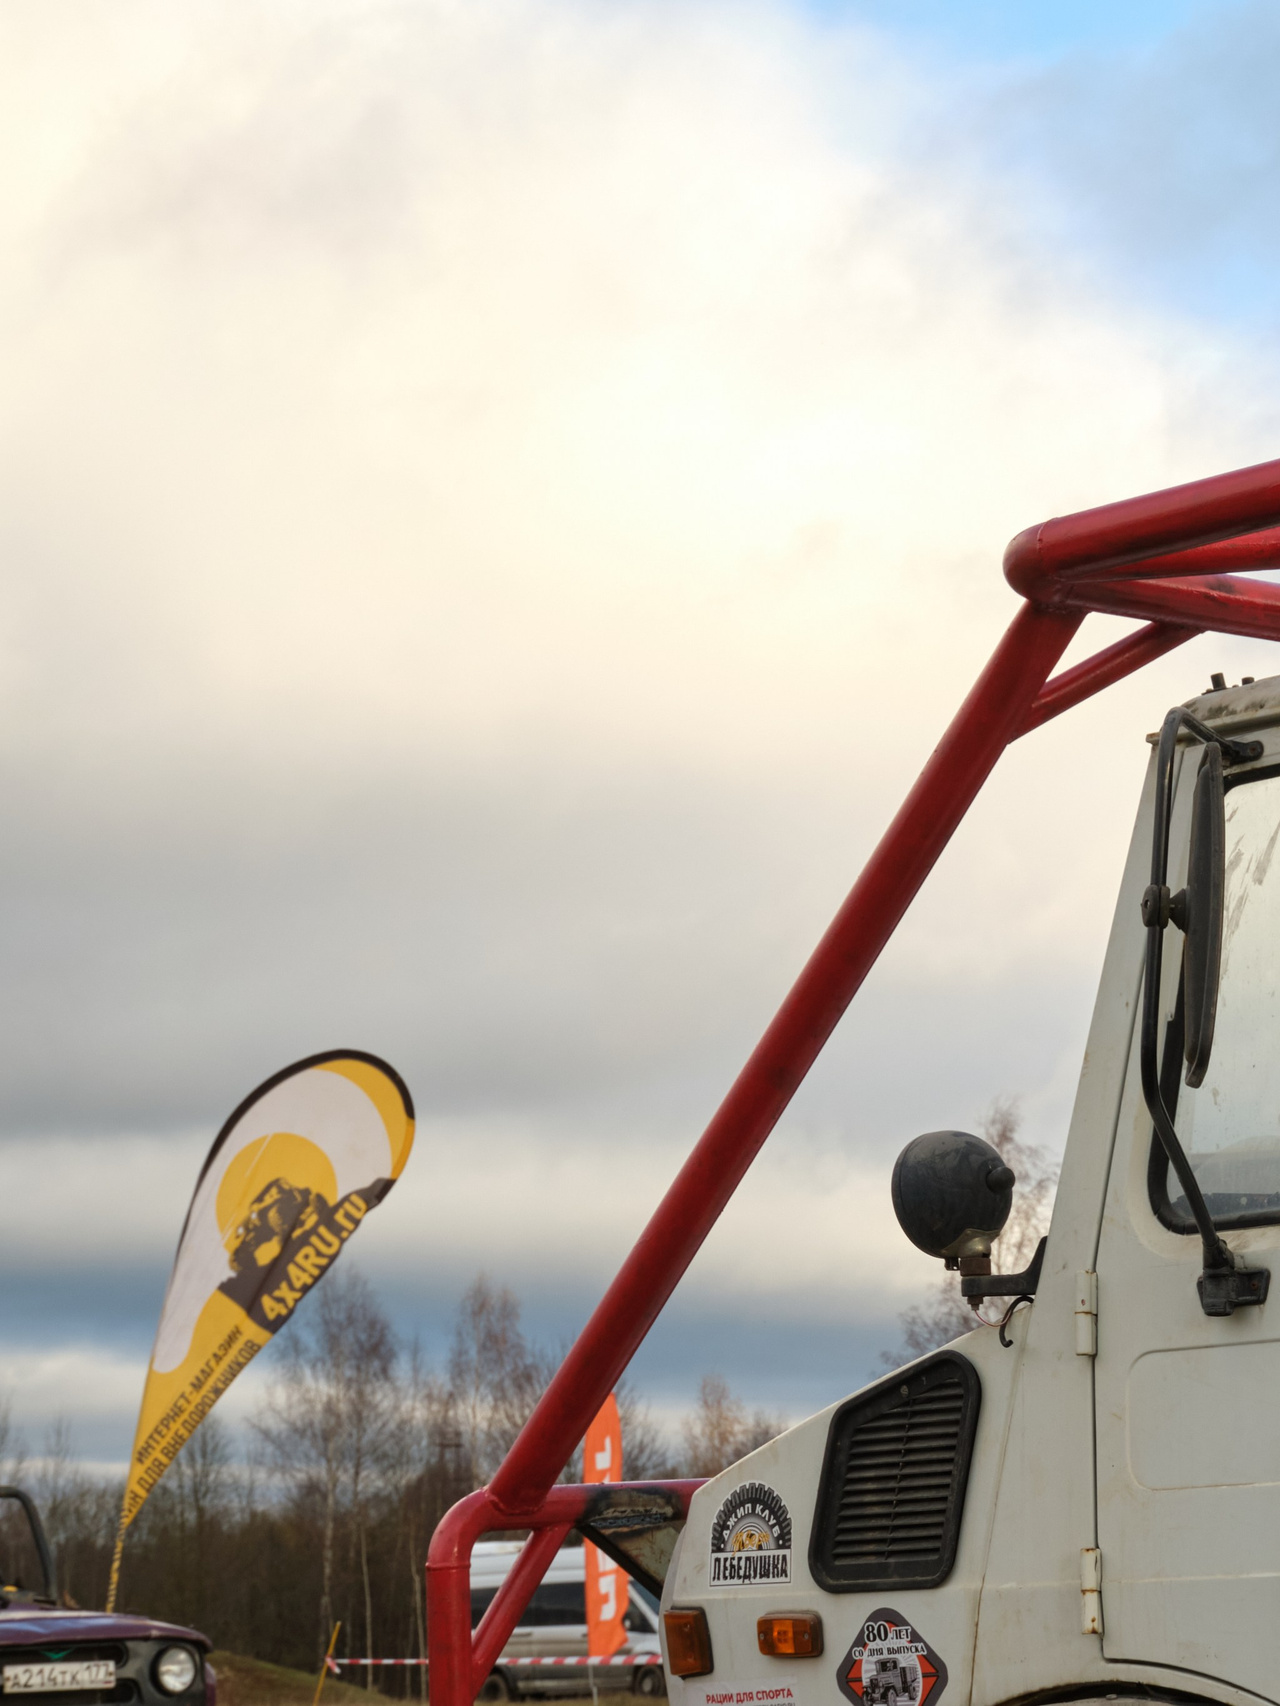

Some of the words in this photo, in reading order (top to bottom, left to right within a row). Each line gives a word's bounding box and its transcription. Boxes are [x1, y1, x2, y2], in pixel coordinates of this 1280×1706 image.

[261, 1193, 368, 1321] 4x4RU.ru
[136, 1325, 243, 1465] ИНТЕРНЕТ-МАГАЗИН
[162, 1339, 262, 1463] ВНЕДОРОЖНИКОВ
[722, 1503, 752, 1541] ДЖИП
[755, 1503, 781, 1538] КЛУБ
[712, 1554, 789, 1584] ЛЕБЕДУШКА
[865, 1623, 889, 1643] 80
[891, 1628, 911, 1641] ЛЕТ
[853, 1648, 864, 1658] СО
[867, 1647, 884, 1658] ДНЯ
[886, 1644, 926, 1656] ВЫПУСКА
[706, 1692, 735, 1705] РАЦИИ
[736, 1691, 754, 1703] ДЛЯ
[756, 1687, 794, 1701] СПОРТА
